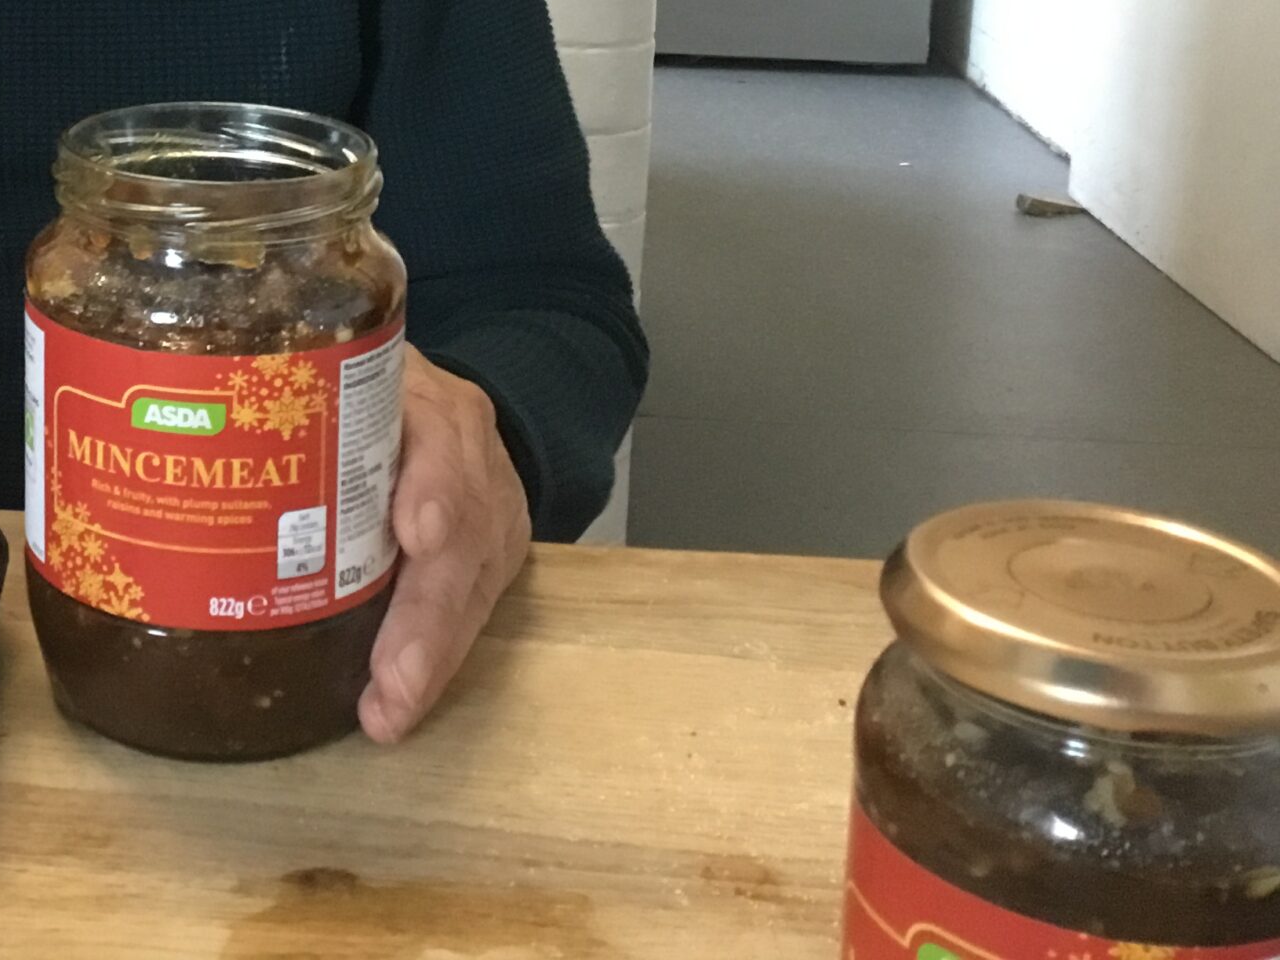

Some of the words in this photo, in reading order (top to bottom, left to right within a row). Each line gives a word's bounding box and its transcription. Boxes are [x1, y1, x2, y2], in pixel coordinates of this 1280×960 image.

[144, 403, 213, 430] ASDA
[67, 428, 307, 490] MINCEMEAT
[91, 478, 111, 493] Rich
[113, 483, 122, 495] &
[156, 495, 180, 508] with
[182, 498, 219, 511] plump
[106, 499, 142, 515] raisins
[143, 507, 162, 518] and
[165, 512, 215, 527] warming
[217, 514, 253, 526] spices
[209, 596, 245, 620] 822g
